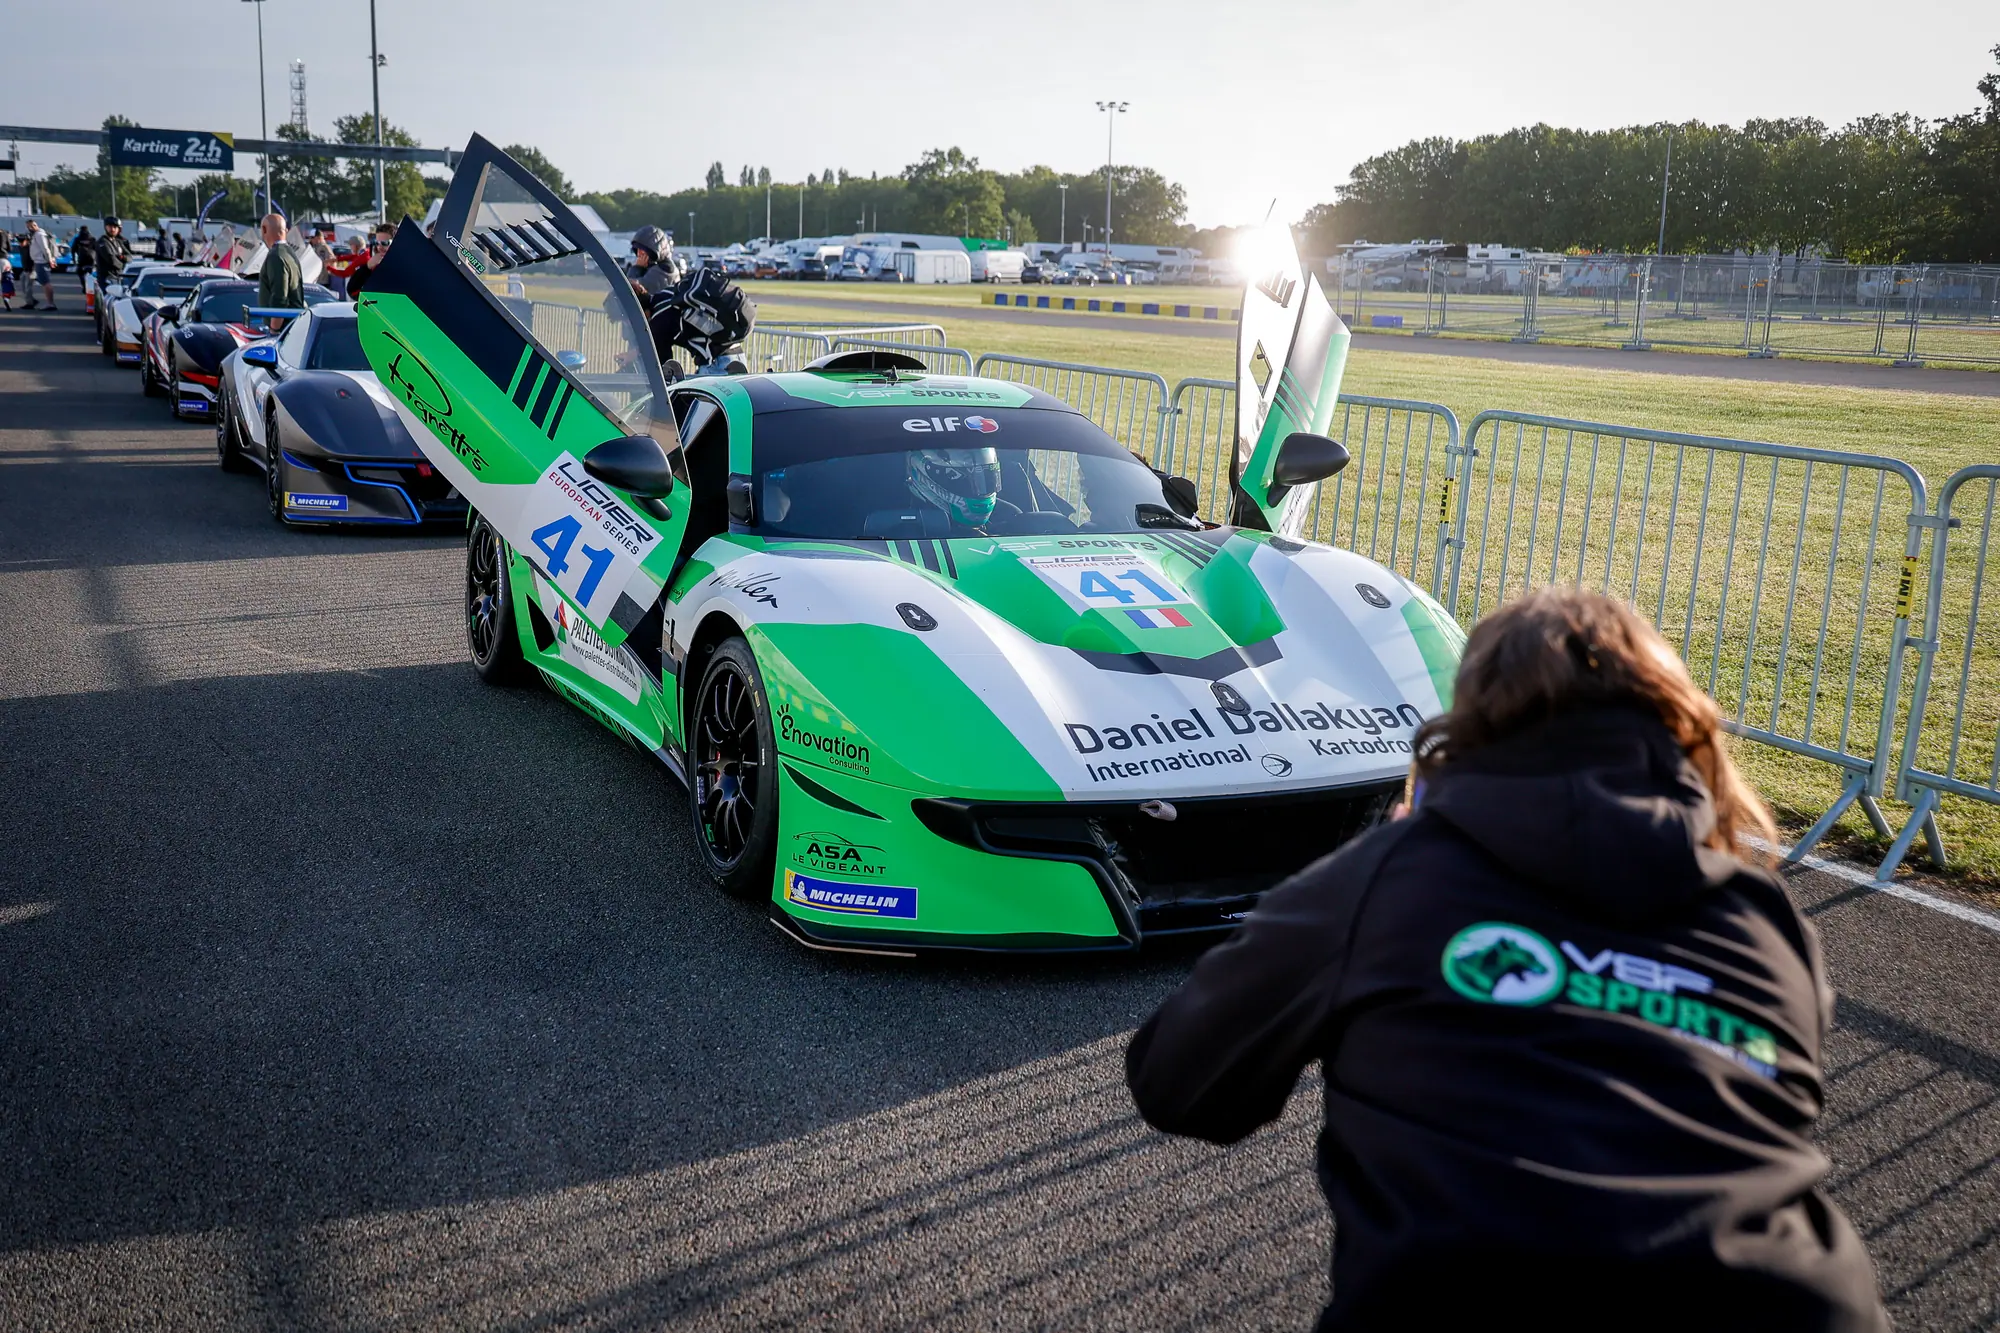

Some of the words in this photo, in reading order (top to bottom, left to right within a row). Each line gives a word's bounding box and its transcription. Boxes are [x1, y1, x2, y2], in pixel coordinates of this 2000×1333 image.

[123, 138, 180, 157] Karting
[446, 231, 464, 249] VSF
[462, 249, 485, 272] SPORTS
[829, 389, 906, 399] VSF
[910, 389, 1001, 399] SPORTS
[902, 415, 962, 433] elf
[297, 498, 340, 506] MICHELIN
[558, 461, 654, 544] LIGIER
[549, 471, 603, 522] EUROPEAN
[602, 520, 640, 556] SERIES
[968, 541, 1054, 556] VSF
[1057, 540, 1159, 551] SPORTS
[530, 514, 616, 610] 41
[1029, 555, 1137, 565] LIGIER
[1079, 569, 1179, 604] 41
[1063, 708, 1216, 755] Daniel
[829, 756, 870, 776] Consulting
[1085, 743, 1253, 783] International
[1308, 735, 1414, 756] Kartodro
[806, 842, 863, 862] ASA
[792, 852, 804, 864] LE
[811, 857, 887, 875] VIGEANT
[809, 888, 899, 908] MICHELIN
[1566, 970, 1778, 1066] SPORTS
